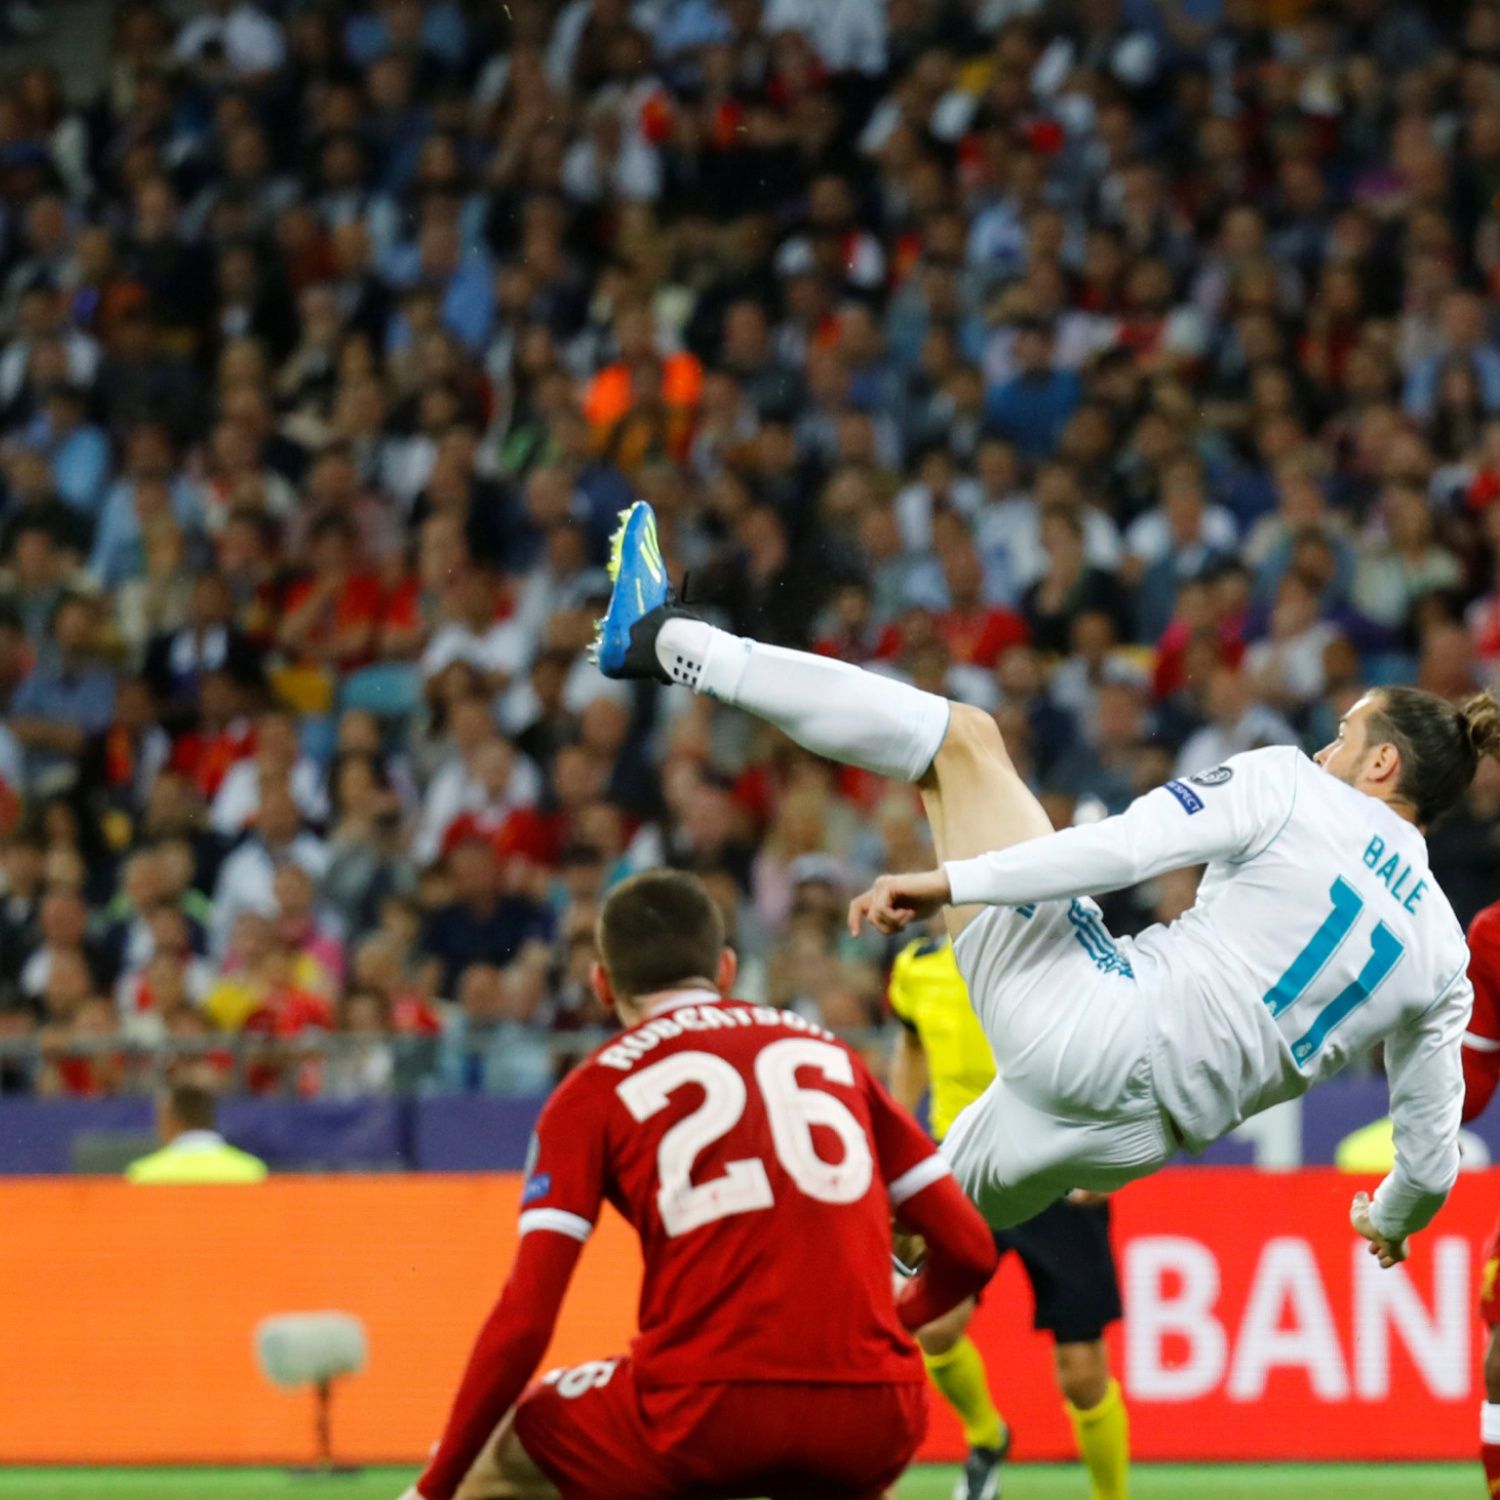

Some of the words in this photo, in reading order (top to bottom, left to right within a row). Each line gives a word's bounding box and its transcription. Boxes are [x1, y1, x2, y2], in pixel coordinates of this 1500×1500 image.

[1262, 874, 1406, 1069] 11
[1362, 834, 1429, 916] BALE
[614, 1037, 873, 1238] 26
